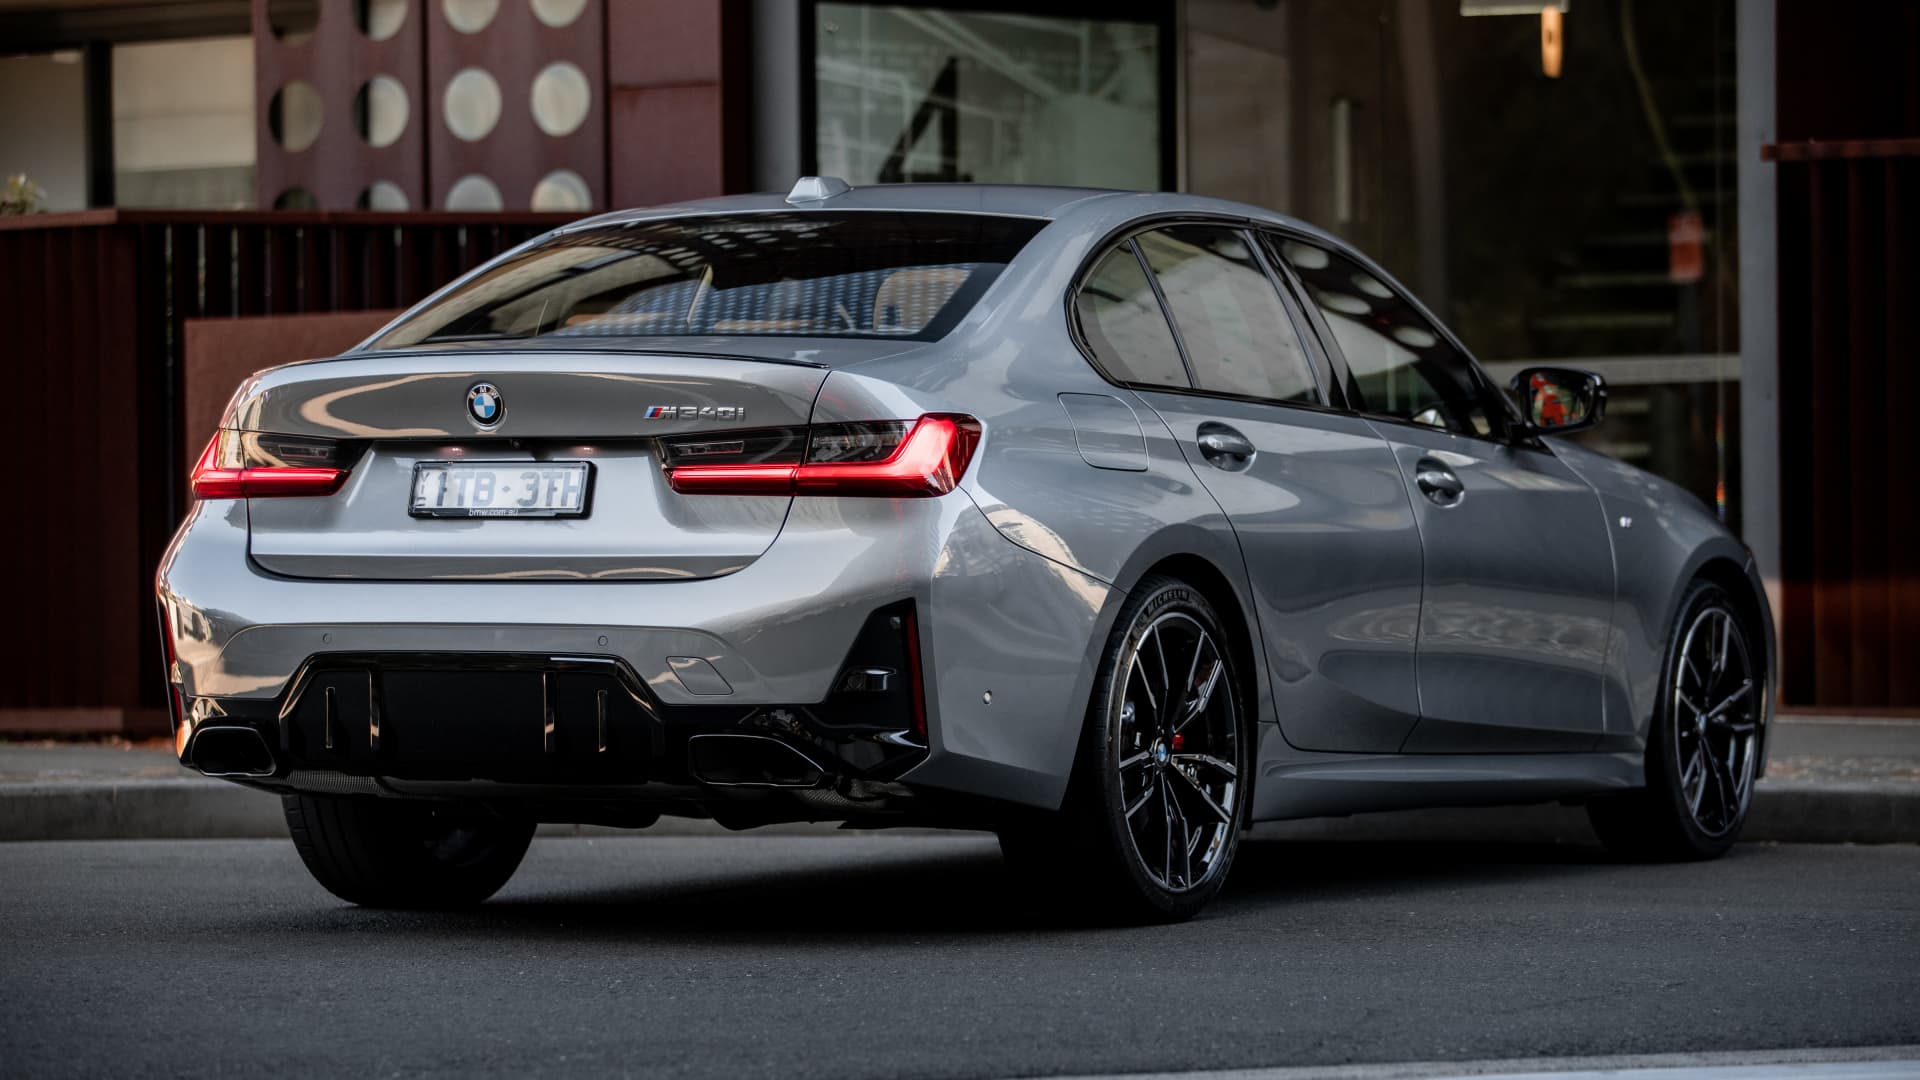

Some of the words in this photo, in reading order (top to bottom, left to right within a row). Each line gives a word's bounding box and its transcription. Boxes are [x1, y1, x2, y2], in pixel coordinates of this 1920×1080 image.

[469, 385, 499, 399] BMW
[468, 508, 518, 517] bmw.com.au
[1148, 590, 1189, 615] MICHELIN
